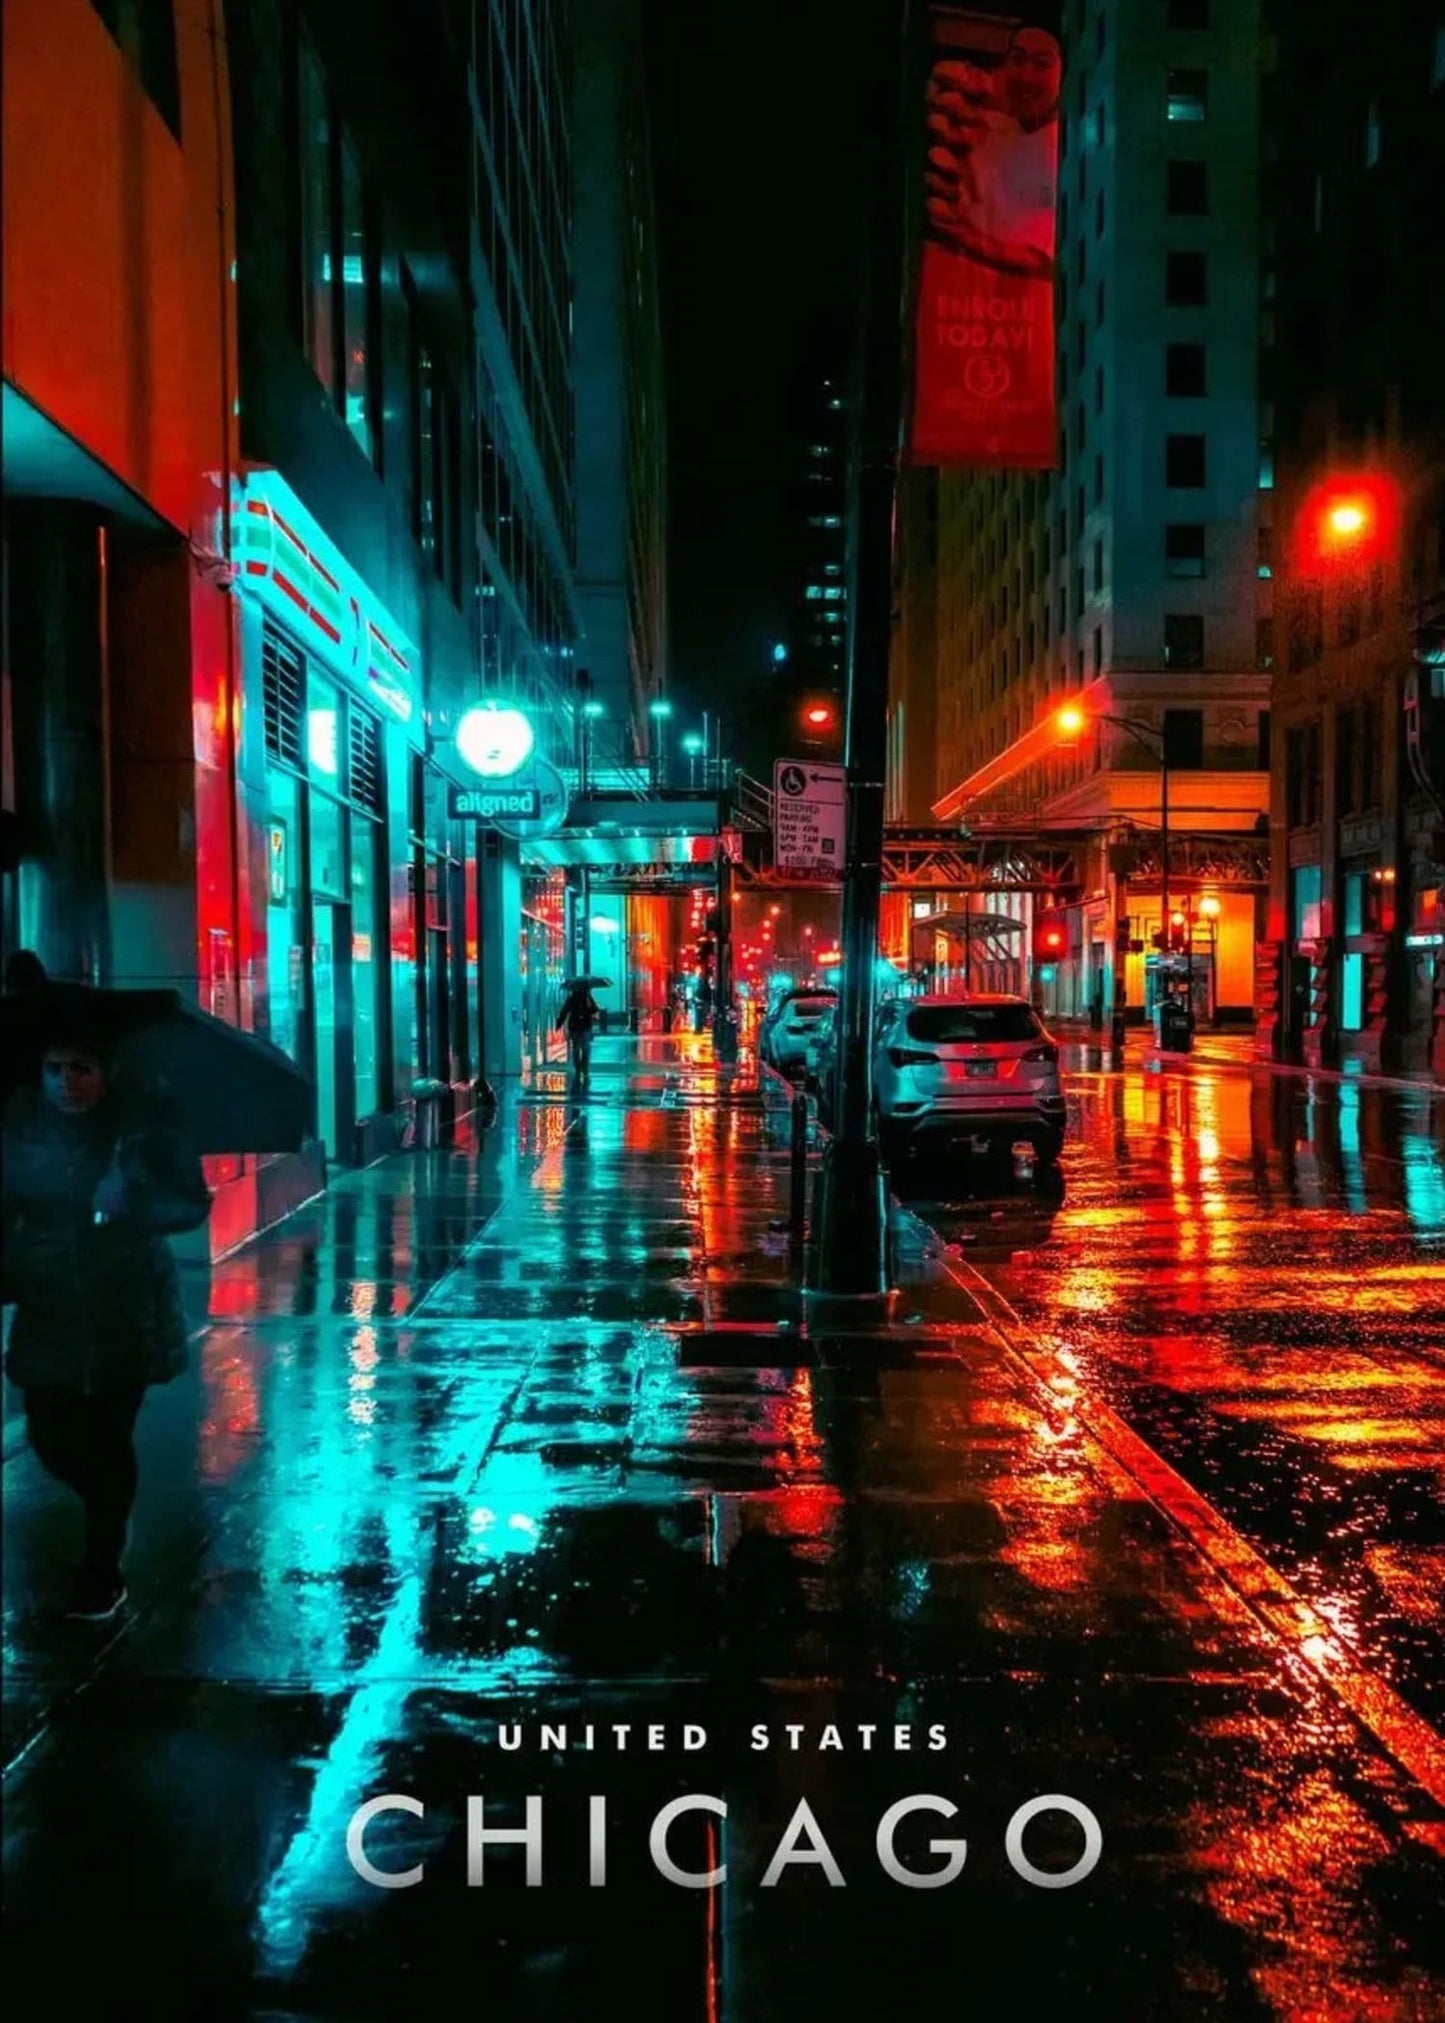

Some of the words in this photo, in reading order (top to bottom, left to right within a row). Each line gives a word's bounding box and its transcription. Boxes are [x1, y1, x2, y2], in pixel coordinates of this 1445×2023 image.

[936, 296, 1034, 322] ENROLL
[456, 791, 534, 817] aligned
[780, 802, 820, 814] RESERVED
[780, 813, 812, 822] PARKING
[780, 843, 797, 852] MON
